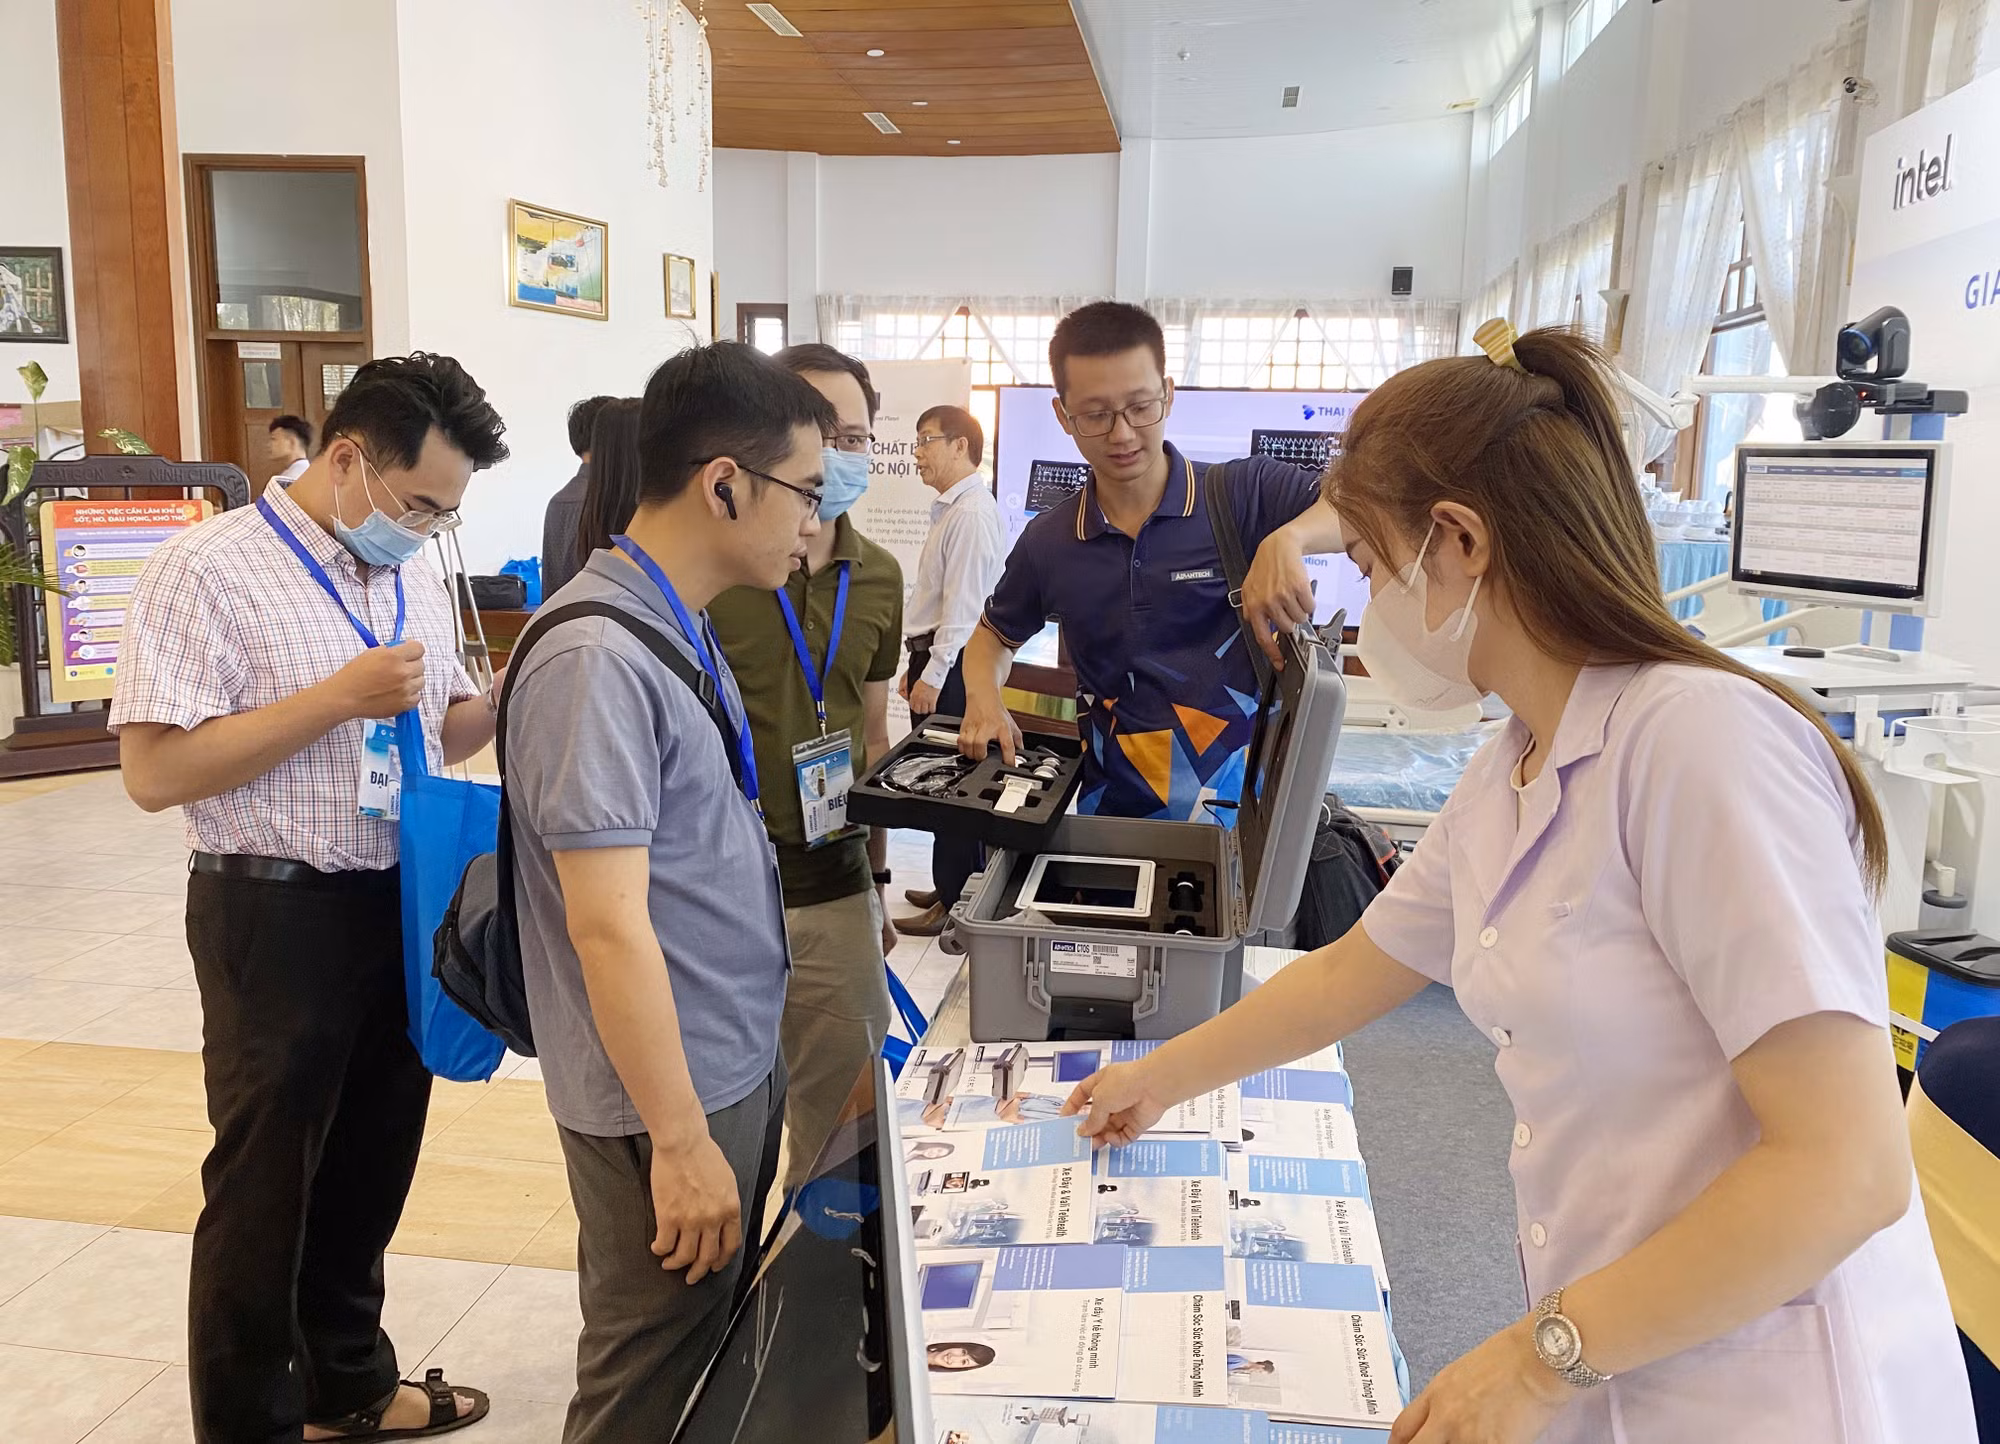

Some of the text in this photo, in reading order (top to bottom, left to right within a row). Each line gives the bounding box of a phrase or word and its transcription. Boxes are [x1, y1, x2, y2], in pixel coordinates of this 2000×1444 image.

[1318, 407, 1344, 416] THAI
[872, 439, 907, 455] CHẤT
[868, 459, 885, 475] ÓC
[887, 460, 910, 478] NỘI
[1304, 556, 1328, 567] ation
[370, 771, 388, 788] ĐẠI
[1062, 1167, 1072, 1176] Xe
[1056, 1208, 1069, 1237] Telehealth
[1191, 1215, 1203, 1240] Telehealth
[1336, 1200, 1346, 1208] Xe
[1341, 1237, 1356, 1264] Telehealth
[1094, 1298, 1104, 1306] Xe
[1193, 1295, 1204, 1313] Chăm
[1193, 1314, 1204, 1326] Sóc
[1351, 1315, 1363, 1332] Chăm
[1088, 1332, 1101, 1351] thông
[1193, 1327, 1204, 1339] Sức
[1354, 1334, 1365, 1346] Sóc
[1089, 1352, 1099, 1369] minh
[1356, 1347, 1368, 1360] Sức
[1190, 1359, 1204, 1379] Thông
[1193, 1380, 1204, 1398] Minh
[1362, 1379, 1375, 1398] Thông
[1366, 1399, 1381, 1415] Minh
